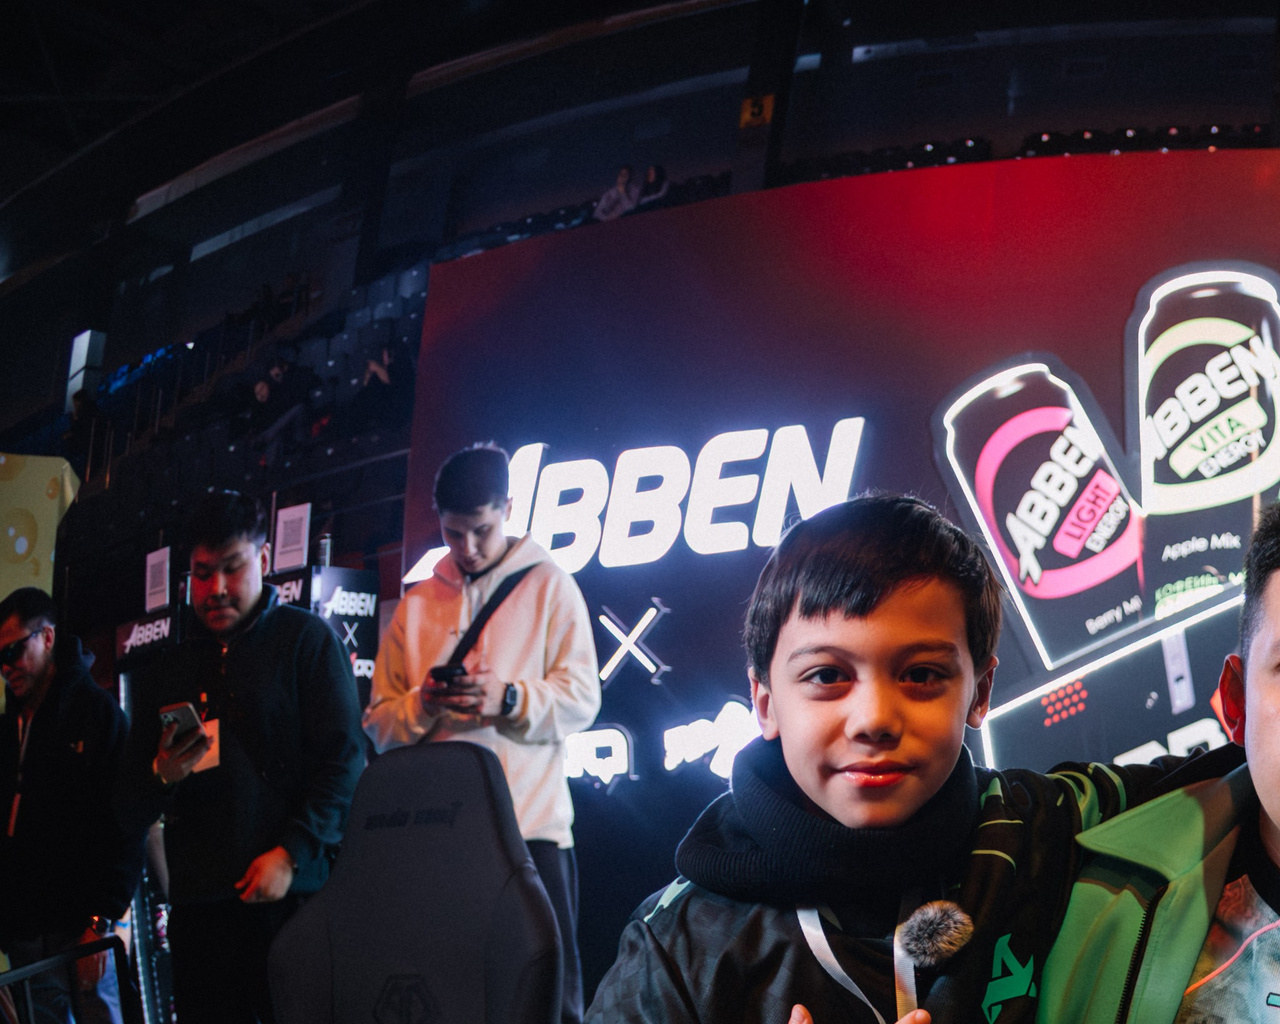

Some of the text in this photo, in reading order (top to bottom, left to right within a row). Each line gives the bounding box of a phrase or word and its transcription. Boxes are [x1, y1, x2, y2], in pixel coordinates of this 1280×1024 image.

[1190, 416, 1247, 453] VITA
[1198, 428, 1267, 479] ENERGY
[1064, 483, 1111, 541] LIGHT
[1161, 532, 1242, 562] Apple Mix
[321, 585, 378, 619] ABBEN
[1085, 605, 1123, 636] Berry
[122, 616, 171, 655] ABBEN
